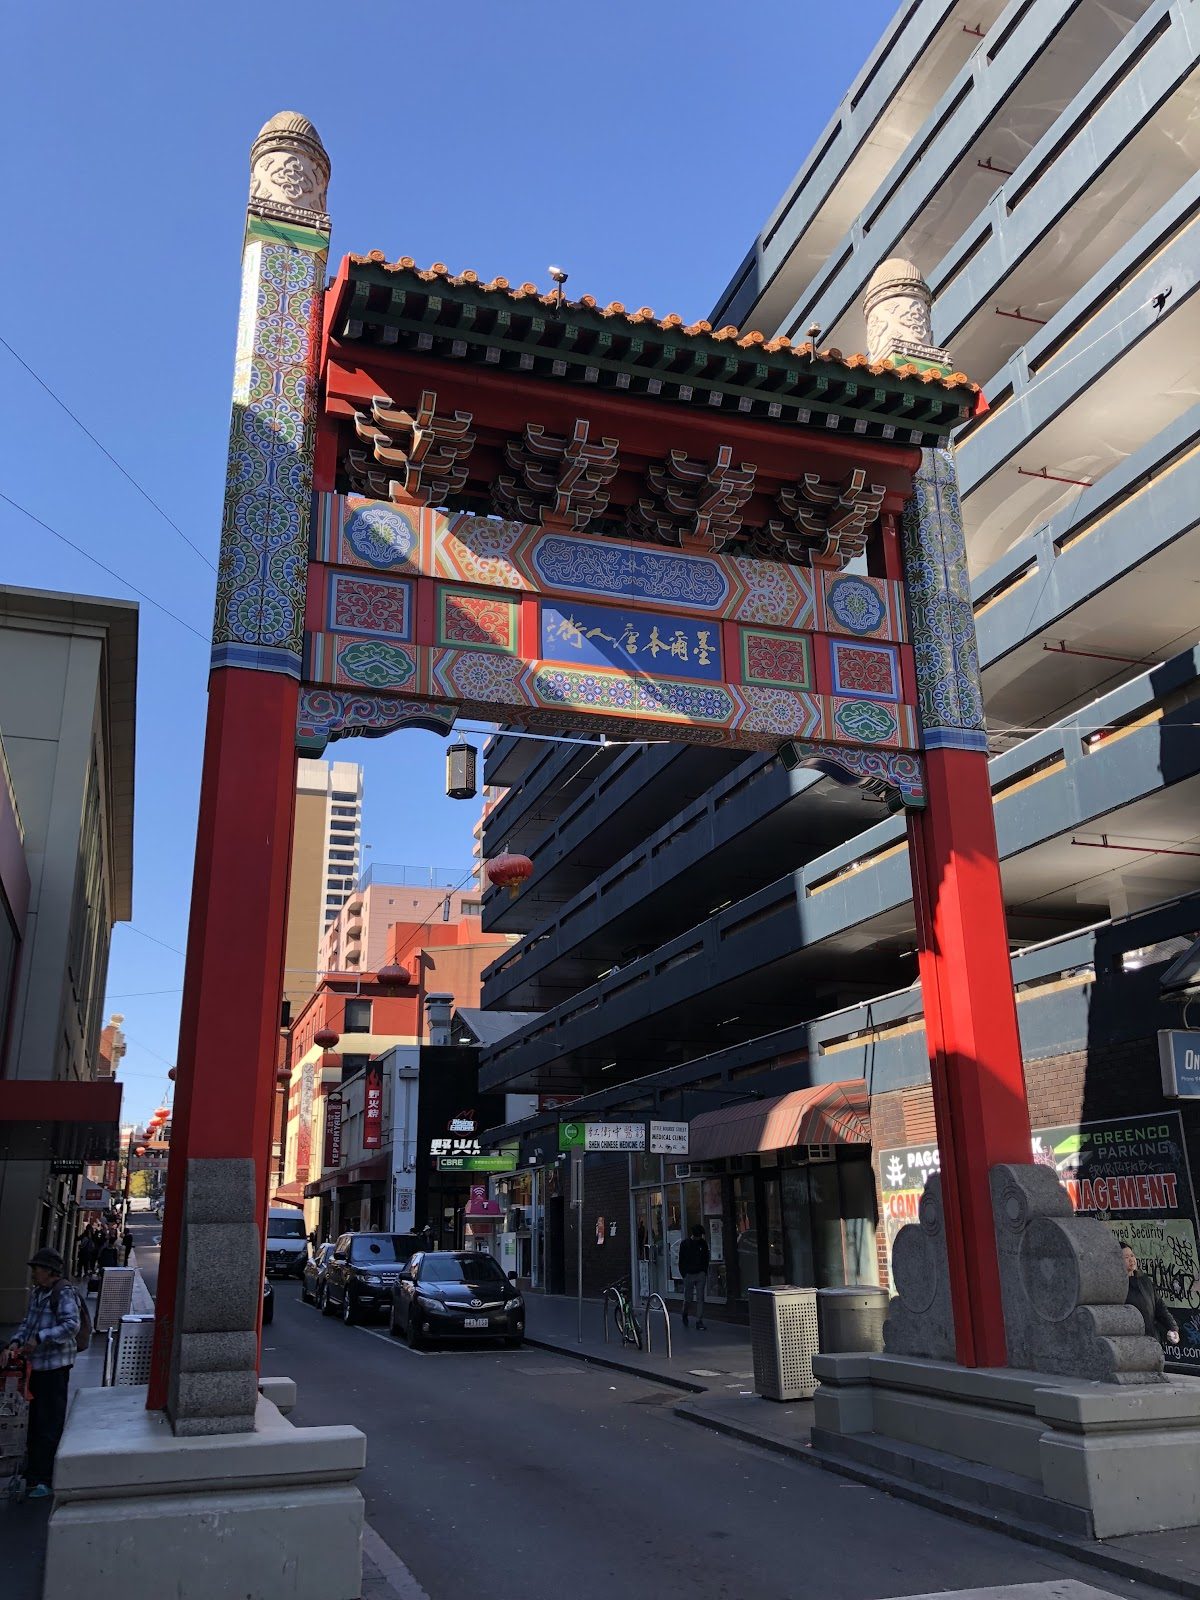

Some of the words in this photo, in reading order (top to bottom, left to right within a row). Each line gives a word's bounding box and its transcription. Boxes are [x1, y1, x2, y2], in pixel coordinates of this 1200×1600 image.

[556, 613, 716, 666] 墨爾本唐人街
[332, 1111, 342, 1164] TEPPANYAKI
[589, 1140, 600, 1149] SHEN
[601, 1140, 619, 1149] CHINESE
[619, 1140, 639, 1149] MEDICINE
[1093, 1125, 1170, 1145] GREENCO
[1098, 1141, 1171, 1160] PARKING
[440, 1158, 464, 1166] CBRE
[1060, 1173, 1179, 1212] NAGEMENT
[1131, 1225, 1164, 1242] Security
